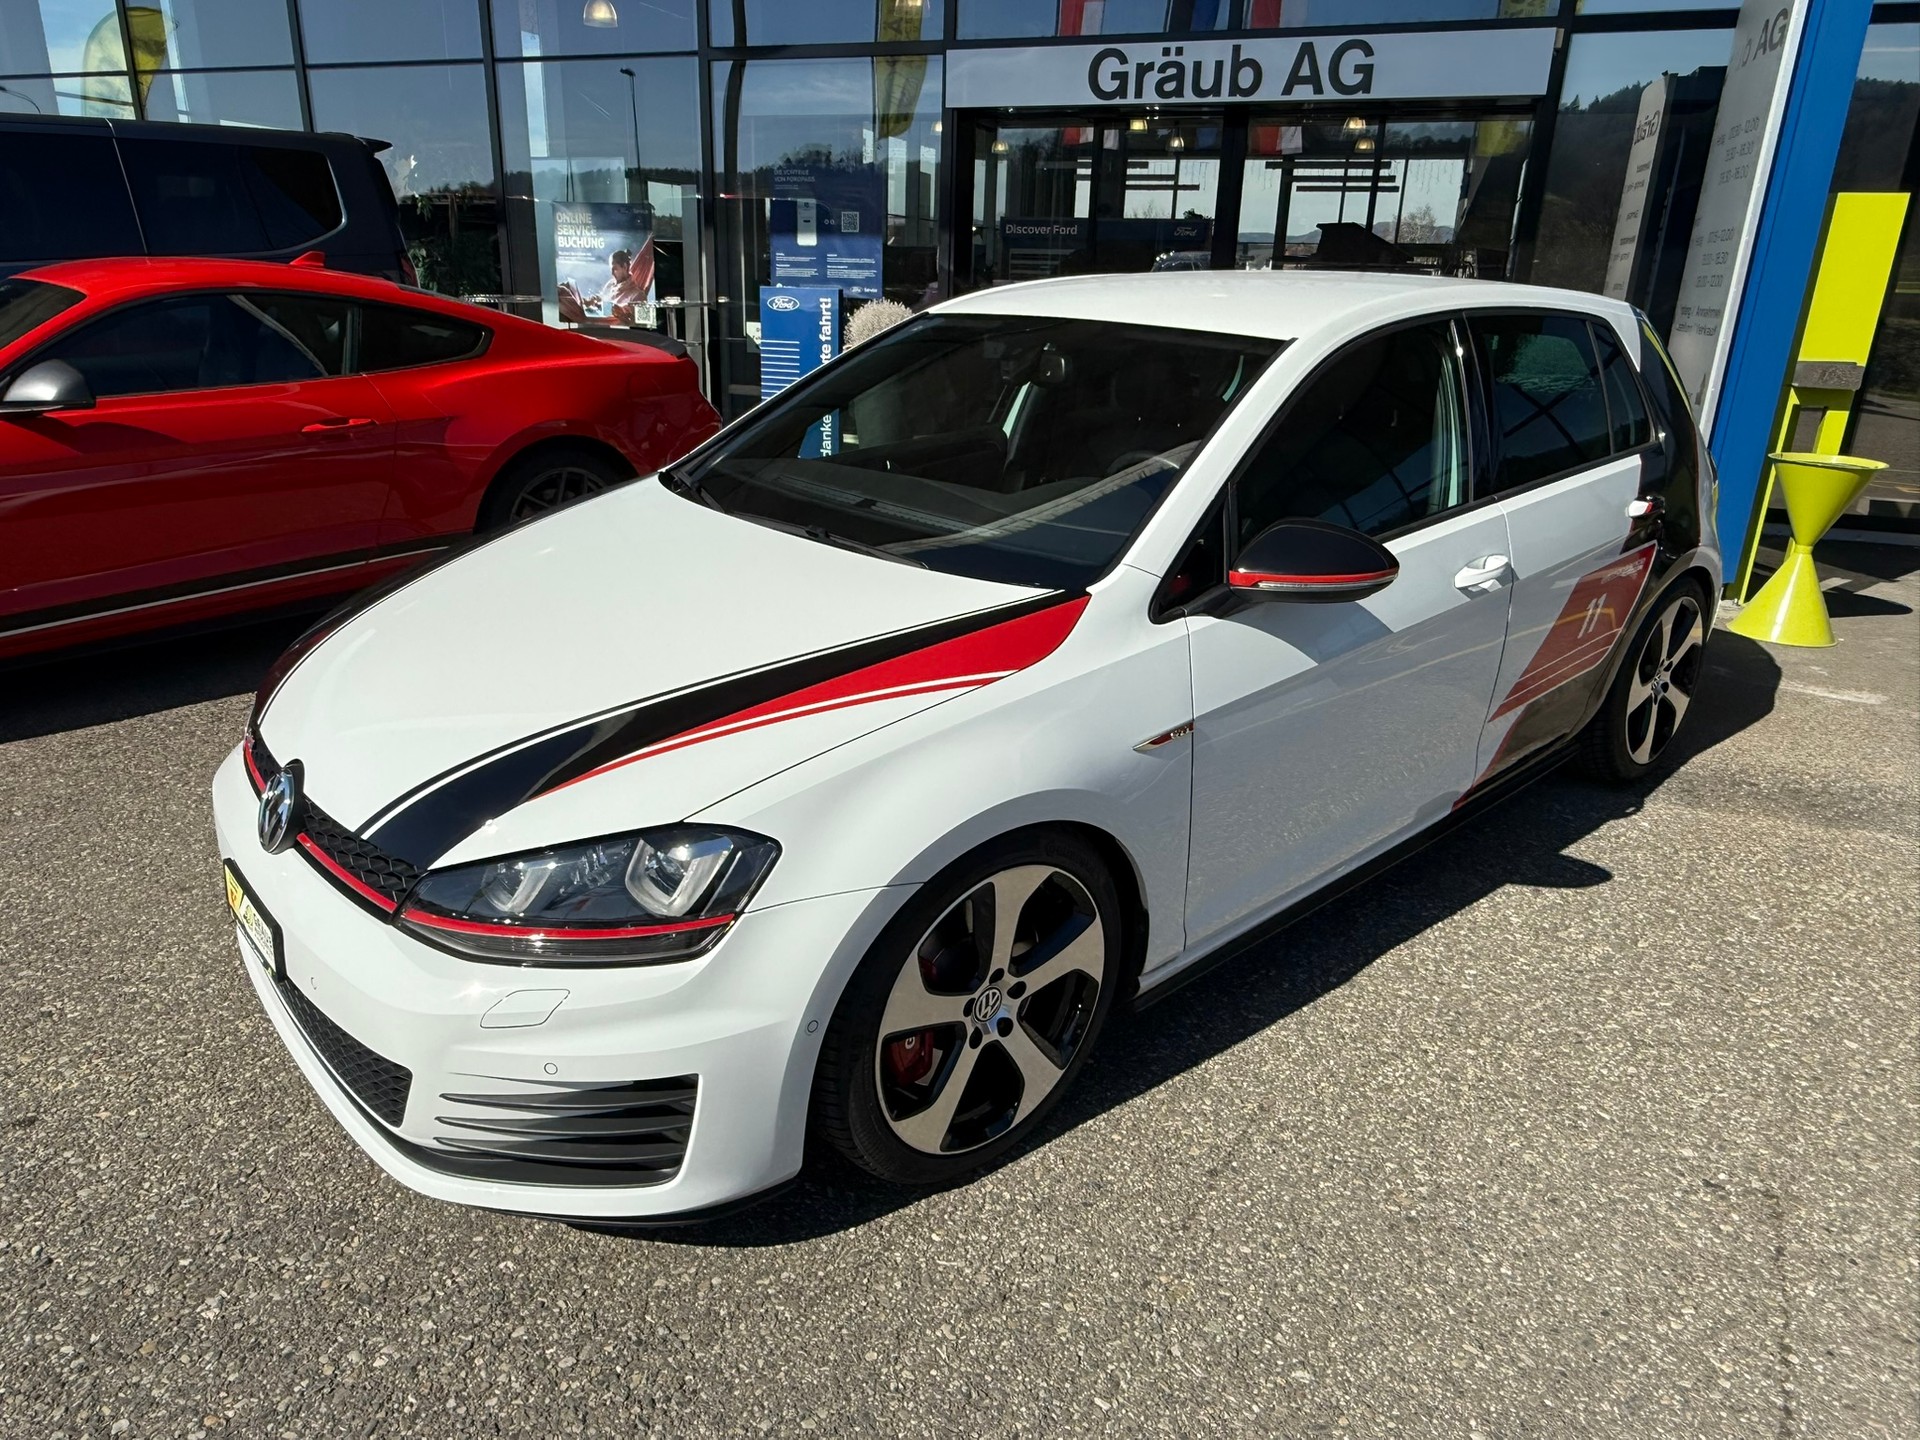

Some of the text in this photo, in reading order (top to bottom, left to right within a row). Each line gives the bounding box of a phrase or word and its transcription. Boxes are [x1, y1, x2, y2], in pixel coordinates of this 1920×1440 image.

[1752, 8, 1789, 61] AG
[1088, 38, 1375, 101] Gräub AG
[556, 212, 592, 224] ONLINE
[557, 225, 597, 236] SERVICE
[1005, 224, 1078, 235] Discover Ford
[558, 236, 605, 248] BUCHUNG
[771, 297, 796, 310] Ford
[819, 297, 832, 341] fahrt!
